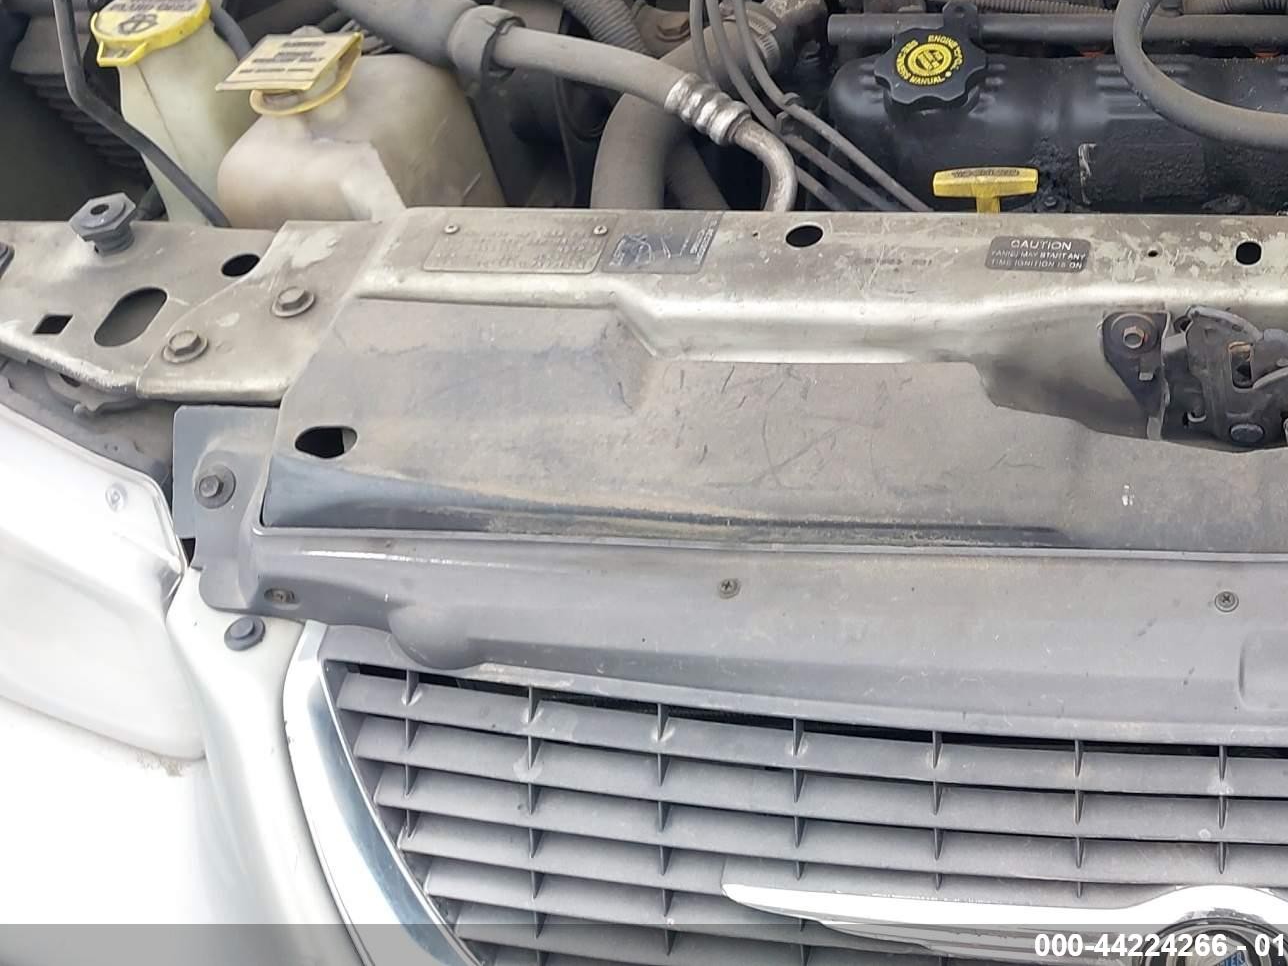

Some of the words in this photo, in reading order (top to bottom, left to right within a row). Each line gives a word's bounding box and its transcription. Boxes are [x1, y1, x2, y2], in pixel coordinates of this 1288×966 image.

[909, 75, 946, 85] MANUAL
[1010, 239, 1072, 250] CAUTION
[1067, 252, 1086, 260] ANY
[1069, 261, 1082, 269] ON
